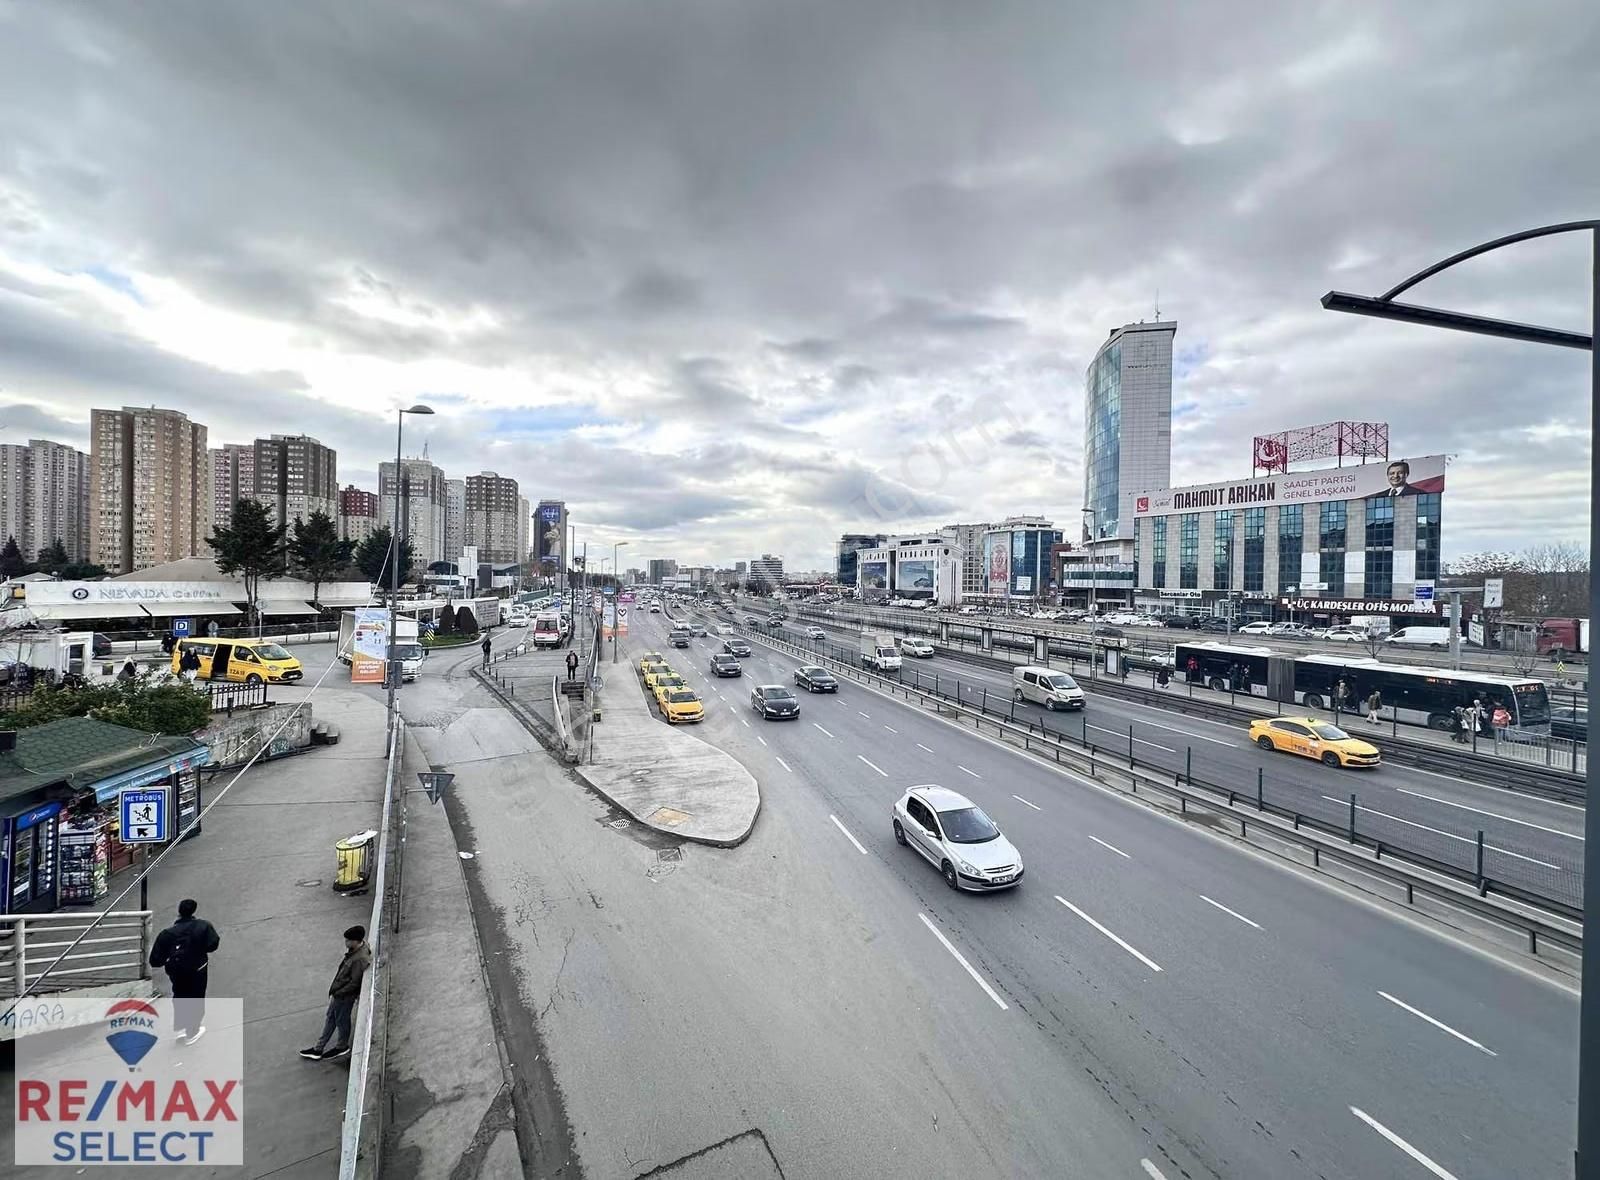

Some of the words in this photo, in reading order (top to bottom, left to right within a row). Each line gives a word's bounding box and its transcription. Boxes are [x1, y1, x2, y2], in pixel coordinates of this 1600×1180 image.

[1283, 479, 1319, 490] SAADET
[1174, 488, 1225, 509] MAHMUT
[1228, 482, 1275, 504] ARIKAN
[1283, 489, 1312, 500] GENEL
[1314, 485, 1356, 497] BAŞKANI
[99, 588, 168, 600] NEVADA
[1297, 598, 1309, 609] ÜÇ
[1310, 600, 1365, 612] KARDEŞLER
[1365, 600, 1389, 611] OFİS
